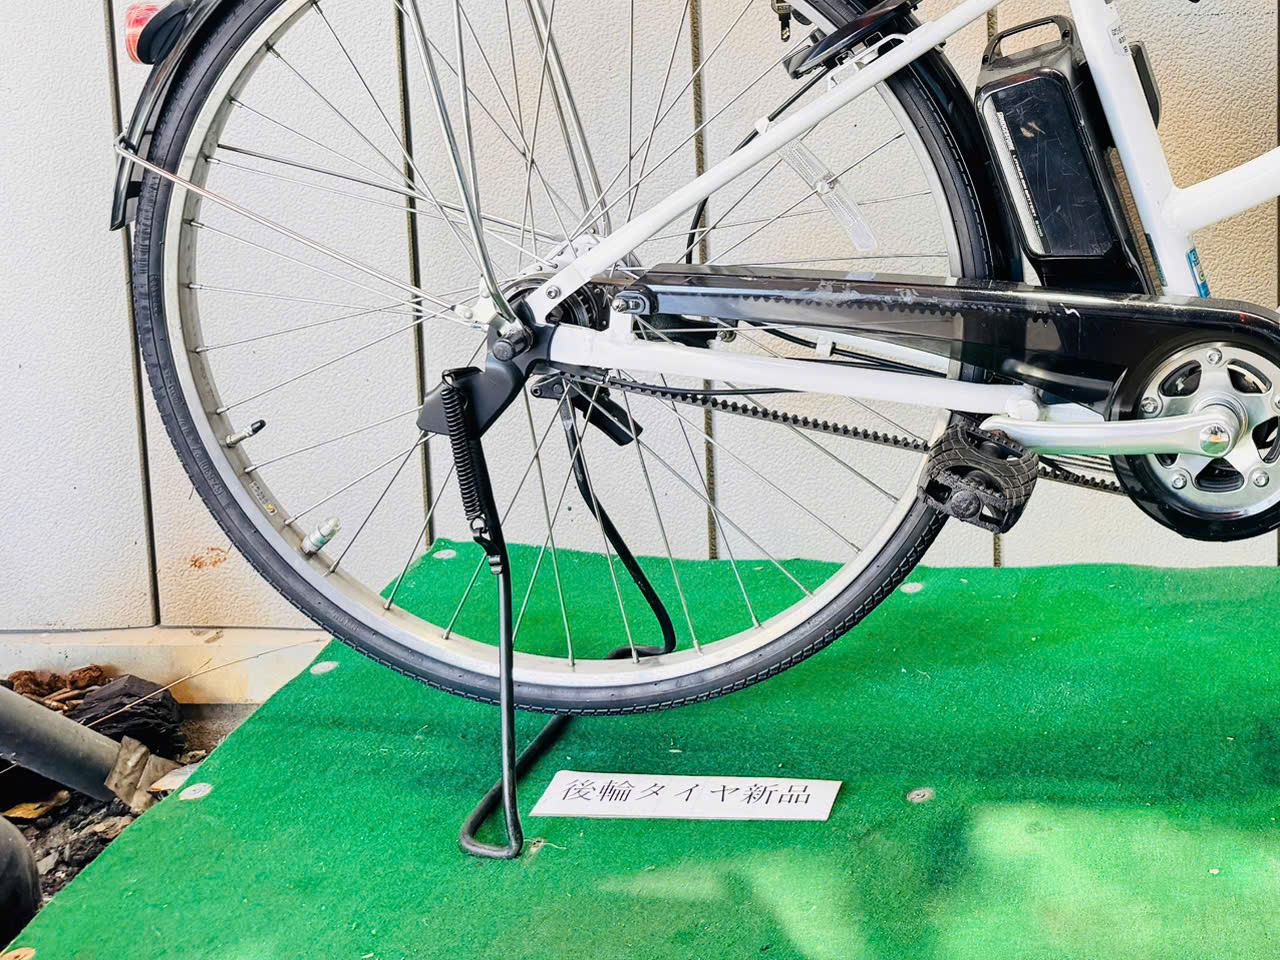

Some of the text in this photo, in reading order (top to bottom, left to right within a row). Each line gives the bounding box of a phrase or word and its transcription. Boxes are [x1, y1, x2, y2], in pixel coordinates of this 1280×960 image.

[561, 778, 812, 806] 後輪タイヤ新品
